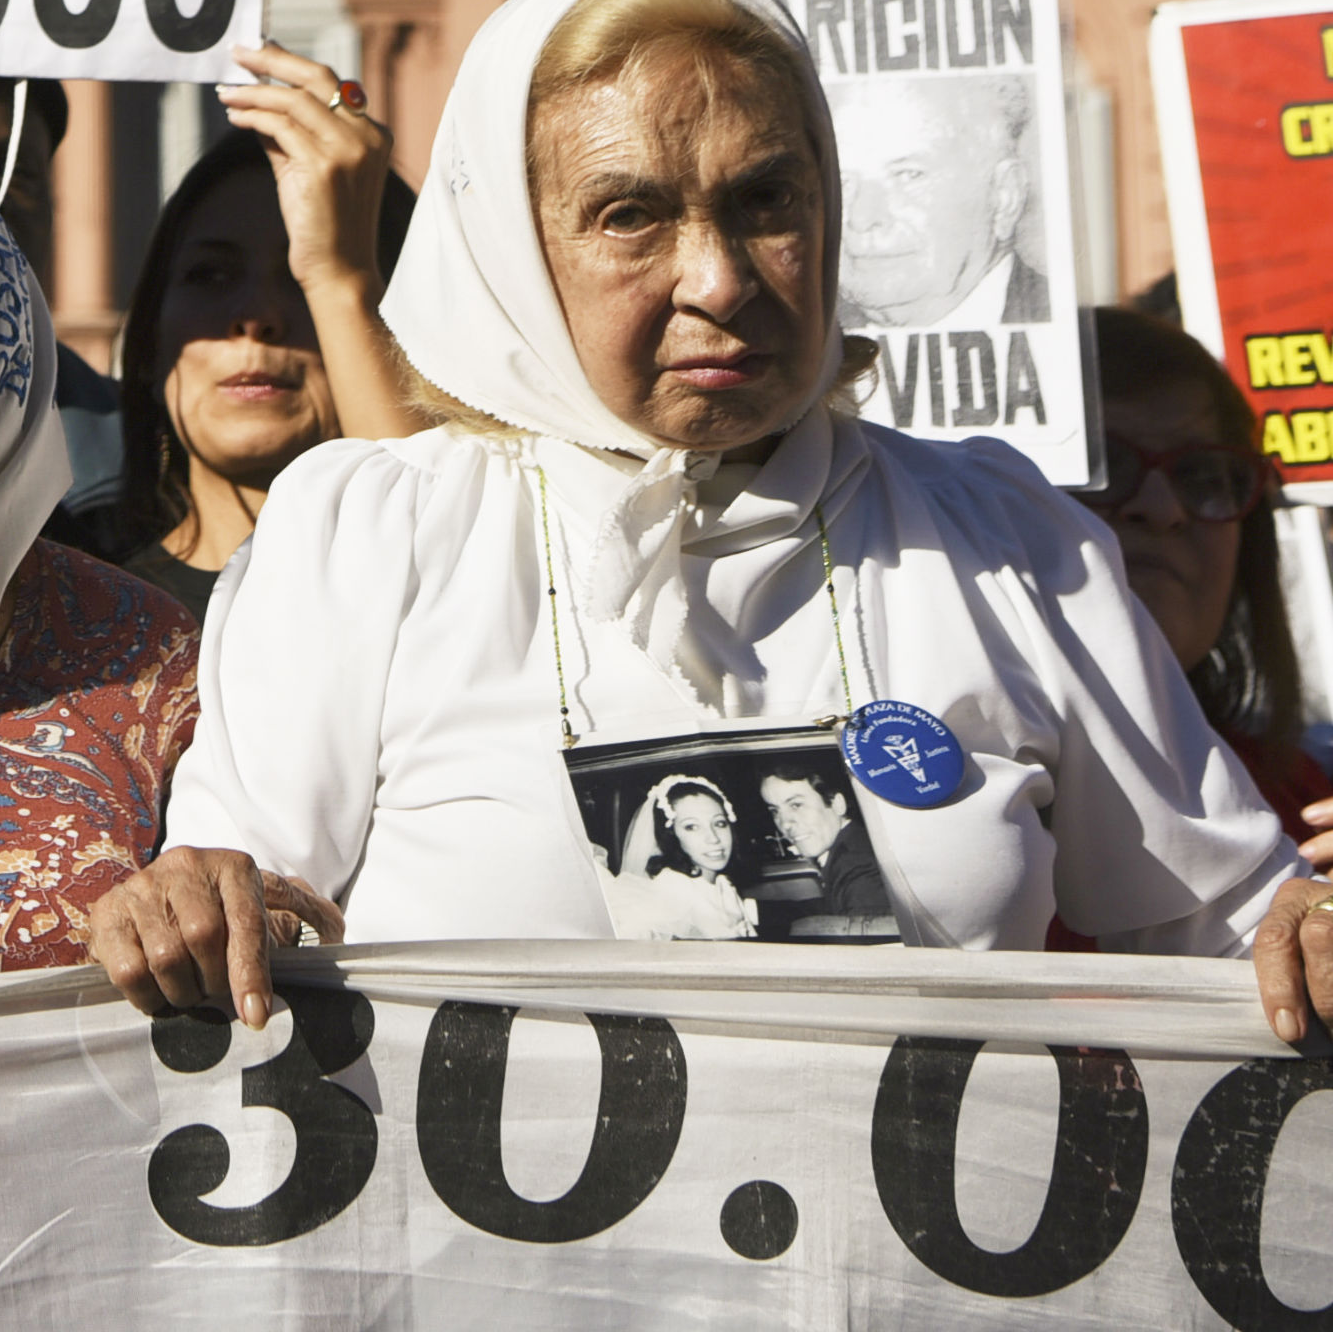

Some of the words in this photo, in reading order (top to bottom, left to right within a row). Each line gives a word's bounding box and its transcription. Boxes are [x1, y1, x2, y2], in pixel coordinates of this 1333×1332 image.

[877, 330, 1048, 427] VIDA
[1262, 408, 1333, 465] AB
[897, 704, 912, 714] DE
[914, 710, 947, 737] MAYO
